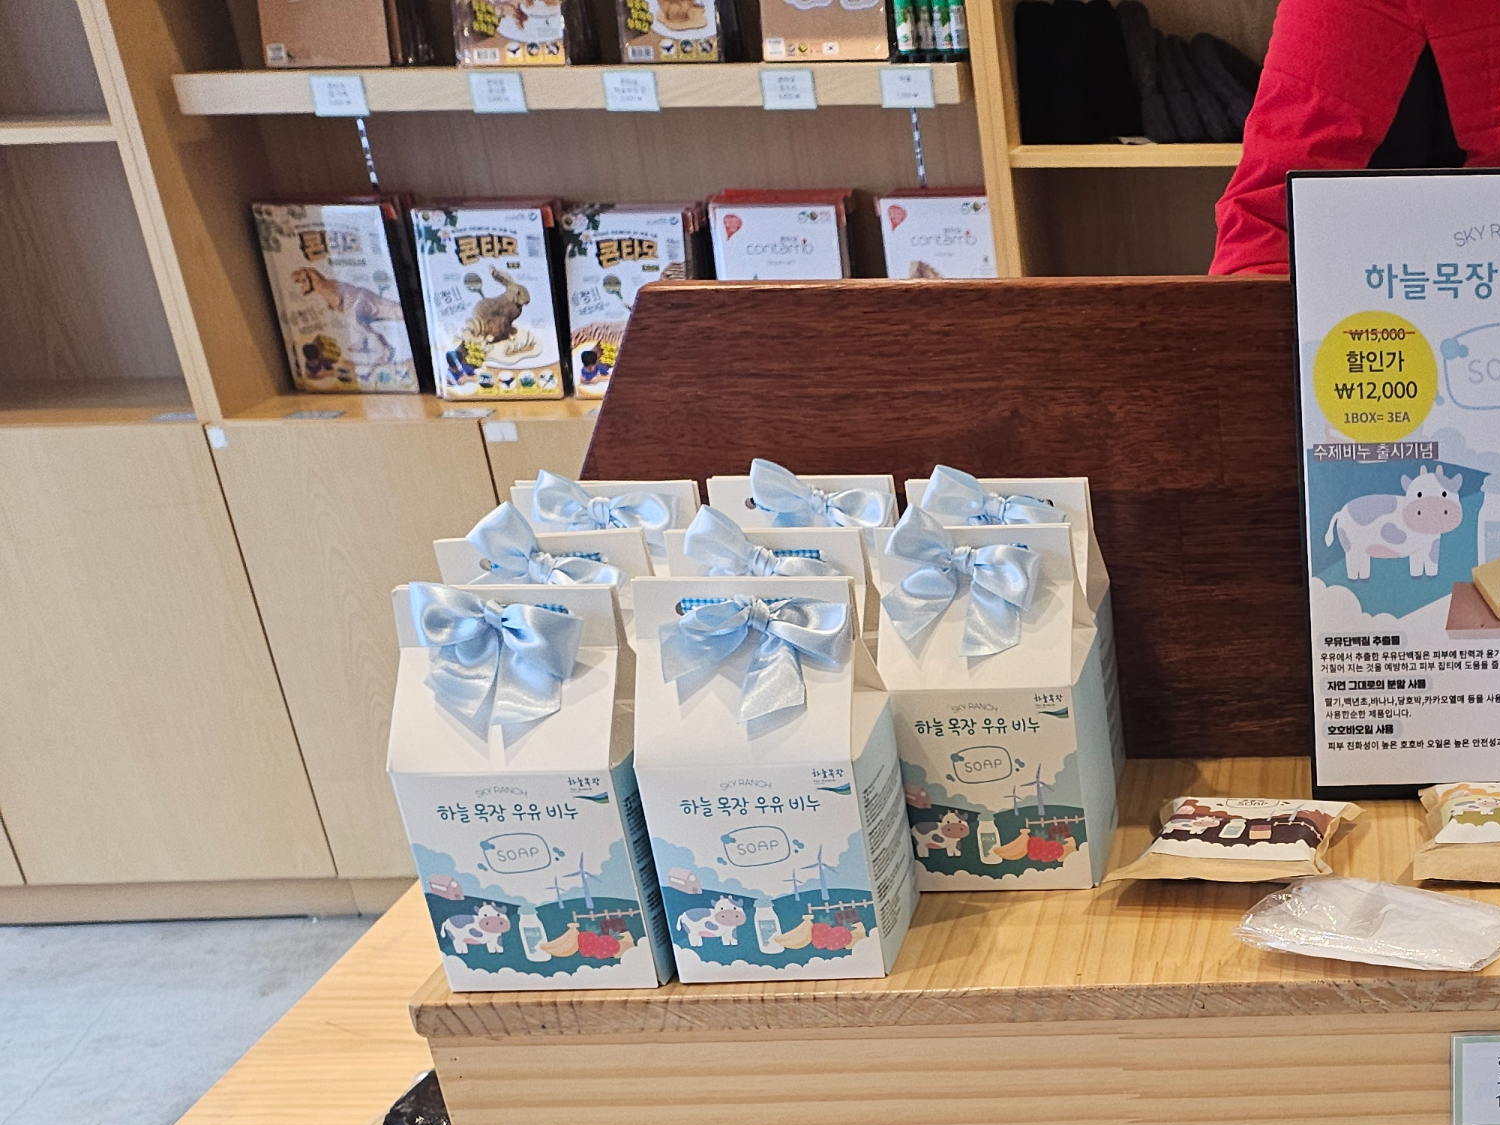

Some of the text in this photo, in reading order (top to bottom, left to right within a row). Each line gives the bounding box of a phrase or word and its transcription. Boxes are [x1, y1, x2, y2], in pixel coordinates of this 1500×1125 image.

[1454, 225, 1485, 247] SKY
[1365, 262, 1498, 300] 하늘목장
[1346, 351, 1404, 372] 할인가
[1335, 381, 1417, 402] ₩12,000
[1388, 412, 1410, 422] 3EA
[1314, 443, 1433, 461] 수제비누 출시기념
[915, 717, 1040, 736] 하늘 목장 우유 비누
[963, 757, 1002, 773] SOAP
[437, 803, 578, 823] 하늘 목장 우유 비누
[680, 795, 820, 817] 하늘 목장 우유 비누
[497, 847, 539, 862] SOAP
[735, 839, 778, 855] SOAP
